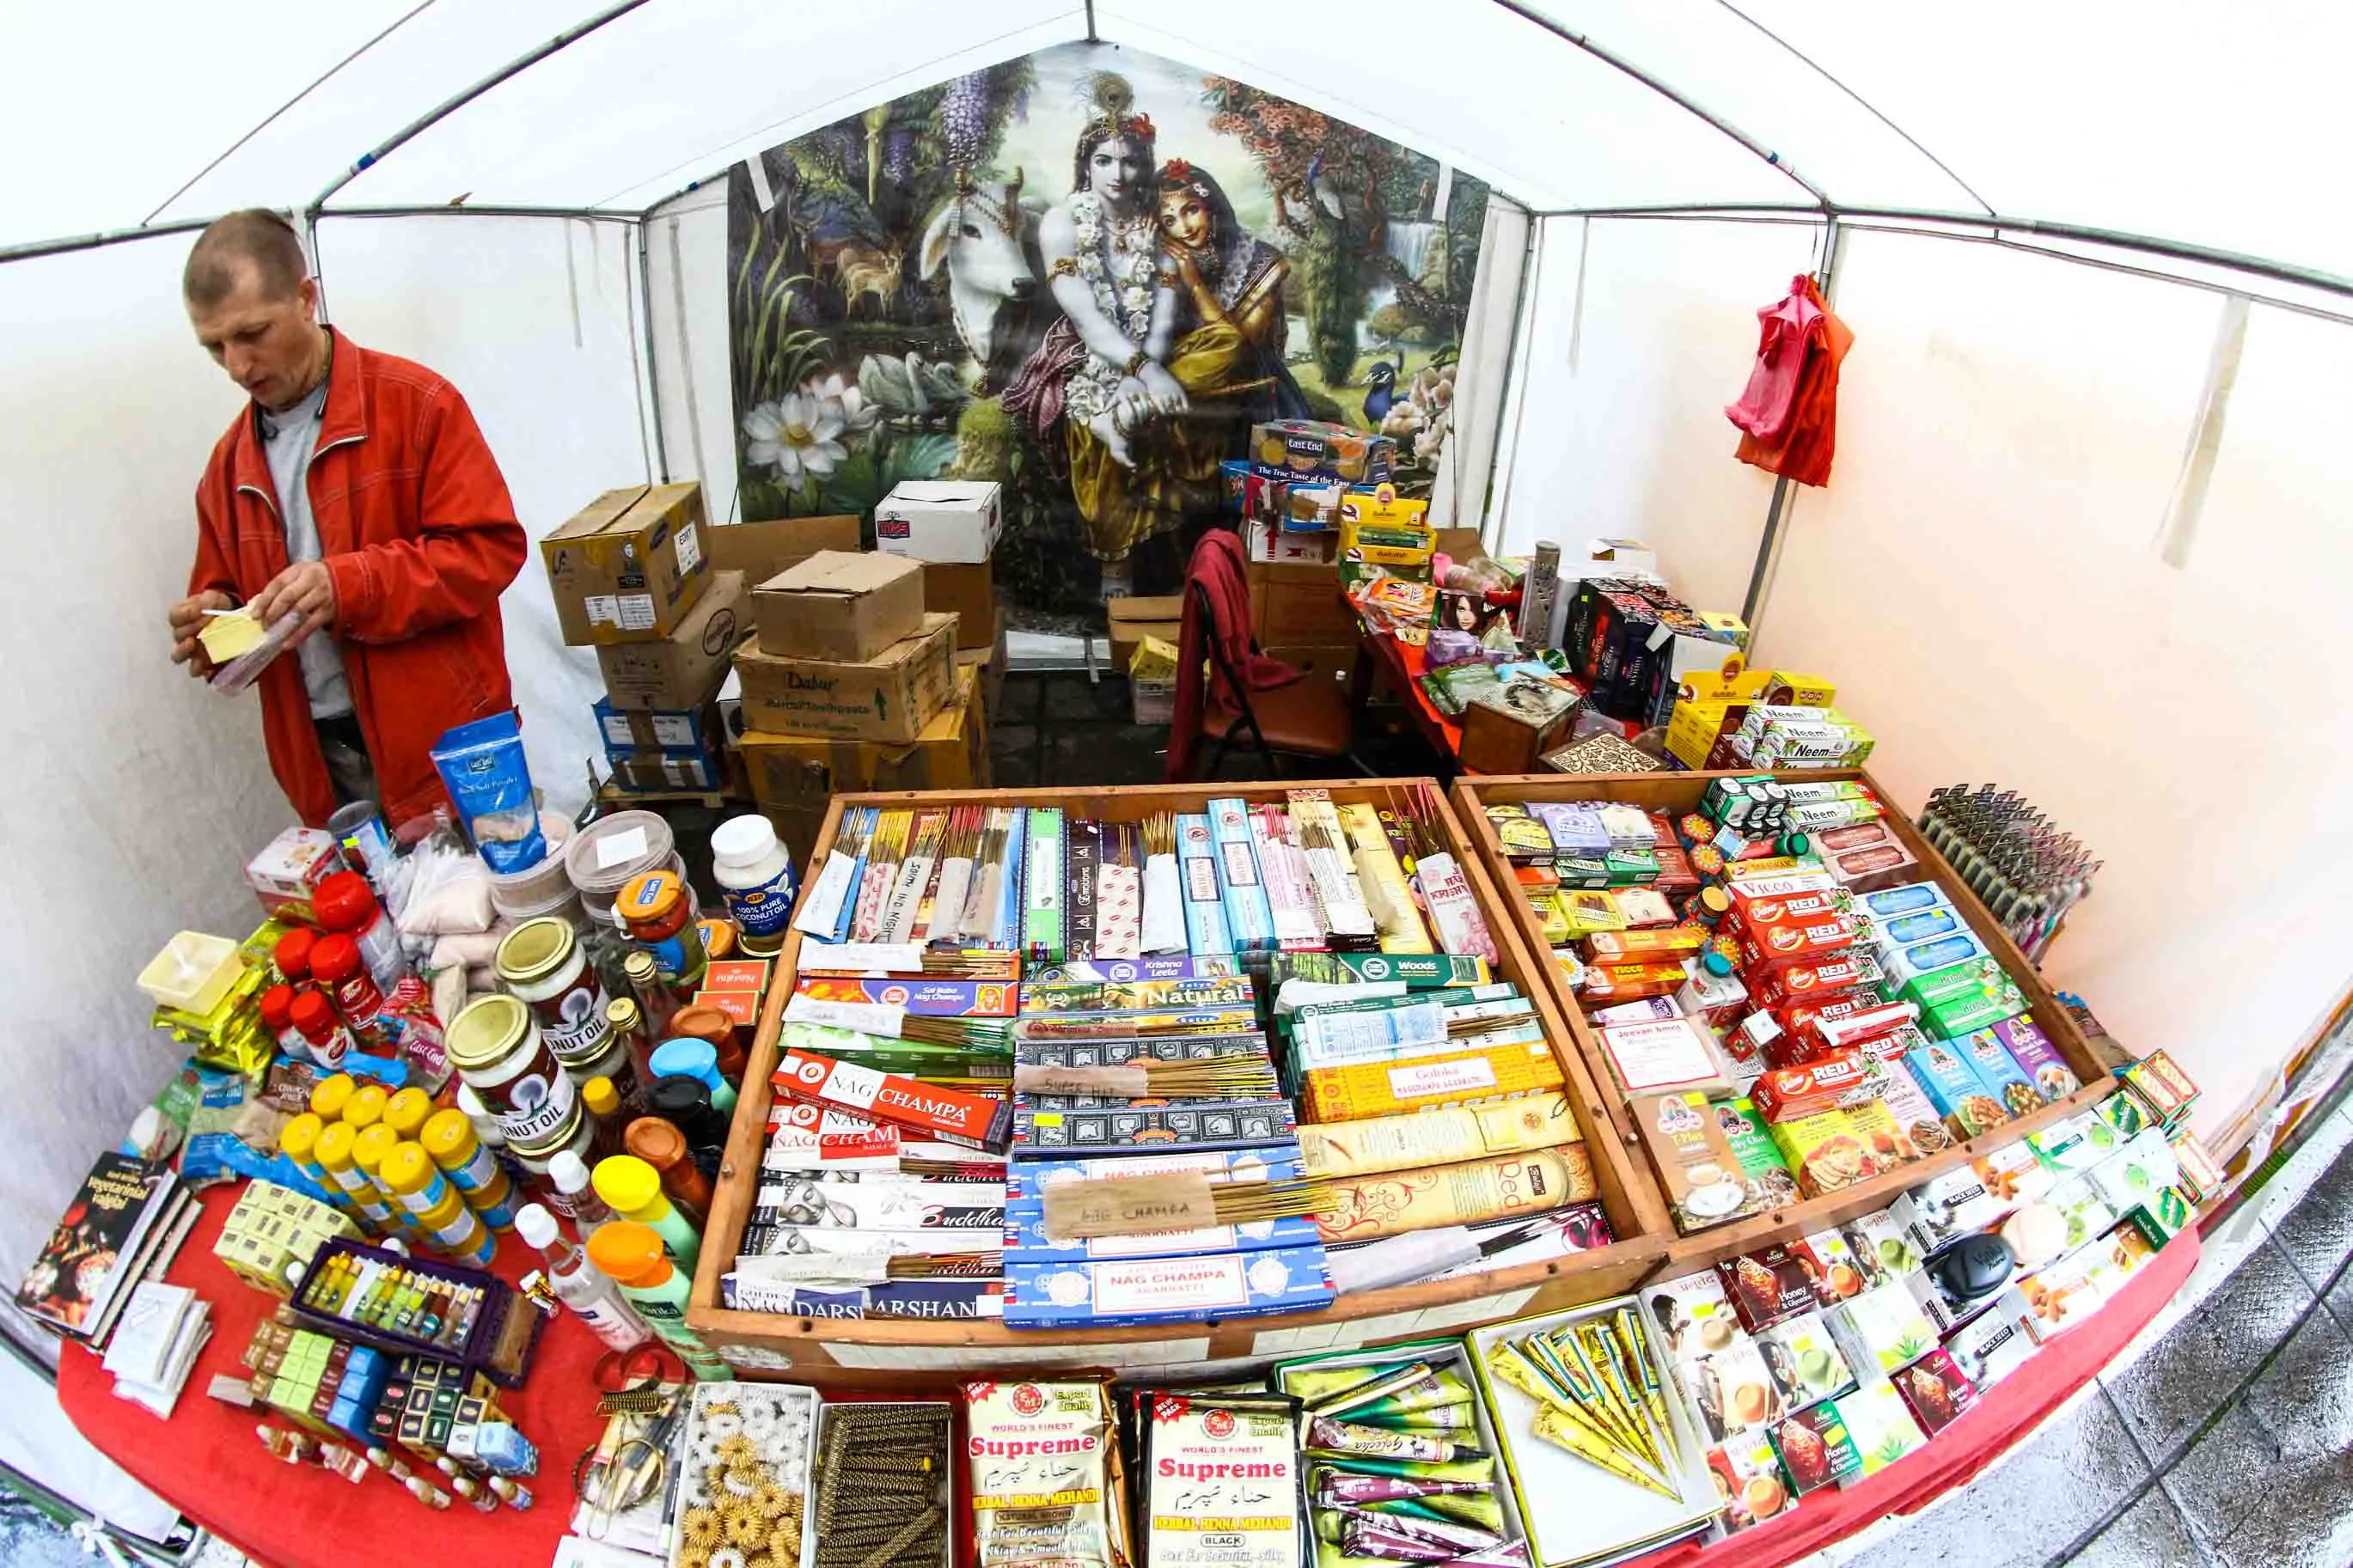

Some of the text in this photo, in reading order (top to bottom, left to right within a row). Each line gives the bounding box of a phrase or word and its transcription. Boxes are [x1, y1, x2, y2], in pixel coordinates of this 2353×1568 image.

[1289, 439, 1323, 451] East End
[1257, 466, 1271, 474] The
[1274, 468, 1288, 477] True
[1290, 471, 1309, 481] Taste
[1319, 476, 1332, 485] the
[1334, 478, 1350, 487] East
[1765, 709, 1805, 719] Neem
[1788, 728, 1827, 737] Neem
[1794, 744, 1830, 756] Neem
[1785, 788, 1821, 798] Neem
[1801, 808, 1837, 821] Neem
[1743, 882, 1794, 894] VICCO
[735, 903, 787, 921] COCONUT OIL
[736, 898, 783, 915] 100% PURE
[1752, 896, 1819, 918] Dabur RED
[1772, 925, 1839, 945] Dabur RED
[1398, 961, 1437, 971] Woods
[715, 973, 757, 984] Navratna
[1788, 965, 1847, 985] Dabur RED
[344, 982, 363, 1003] Dabur
[1146, 985, 1244, 1005] Natural
[1821, 1003, 1853, 1017] RED
[352, 1014, 361, 1023] 3
[585, 1018, 606, 1038] OIL
[409, 1040, 444, 1065] East End
[1780, 1061, 1849, 1093] Dabur RED
[829, 1075, 967, 1121] NAG CHAMPA
[542, 1107, 564, 1127] OIL
[774, 1124, 893, 1148] NAG CHAM
[920, 1205, 1004, 1228] Buddha
[1110, 1271, 1226, 1286] NAG CHAMPA
[1777, 1286, 1806, 1302] Honey
[872, 1300, 977, 1317] ARSHAN
[1979, 1328, 2010, 1354] BLACK SEED
[1057, 1400, 1094, 1412] Quality
[1156, 1398, 1174, 1412] NEW
[1161, 1404, 1182, 1419] PACK
[991, 1422, 1073, 1432] WORLD'S FINEST
[1250, 1415, 1285, 1425] Export
[1250, 1428, 1287, 1437] Quality
[969, 1437, 1096, 1460] Supreme
[1183, 1446, 1225, 1455] WORLD'S
[1158, 1458, 1287, 1482] Supreme
[1011, 1493, 1048, 1507] HENNA
[1154, 1516, 1196, 1530] HERBAL
[1199, 1516, 1238, 1530] HENNA
[999, 1527, 1017, 1539] For
[1205, 1536, 1242, 1545] BLACK
